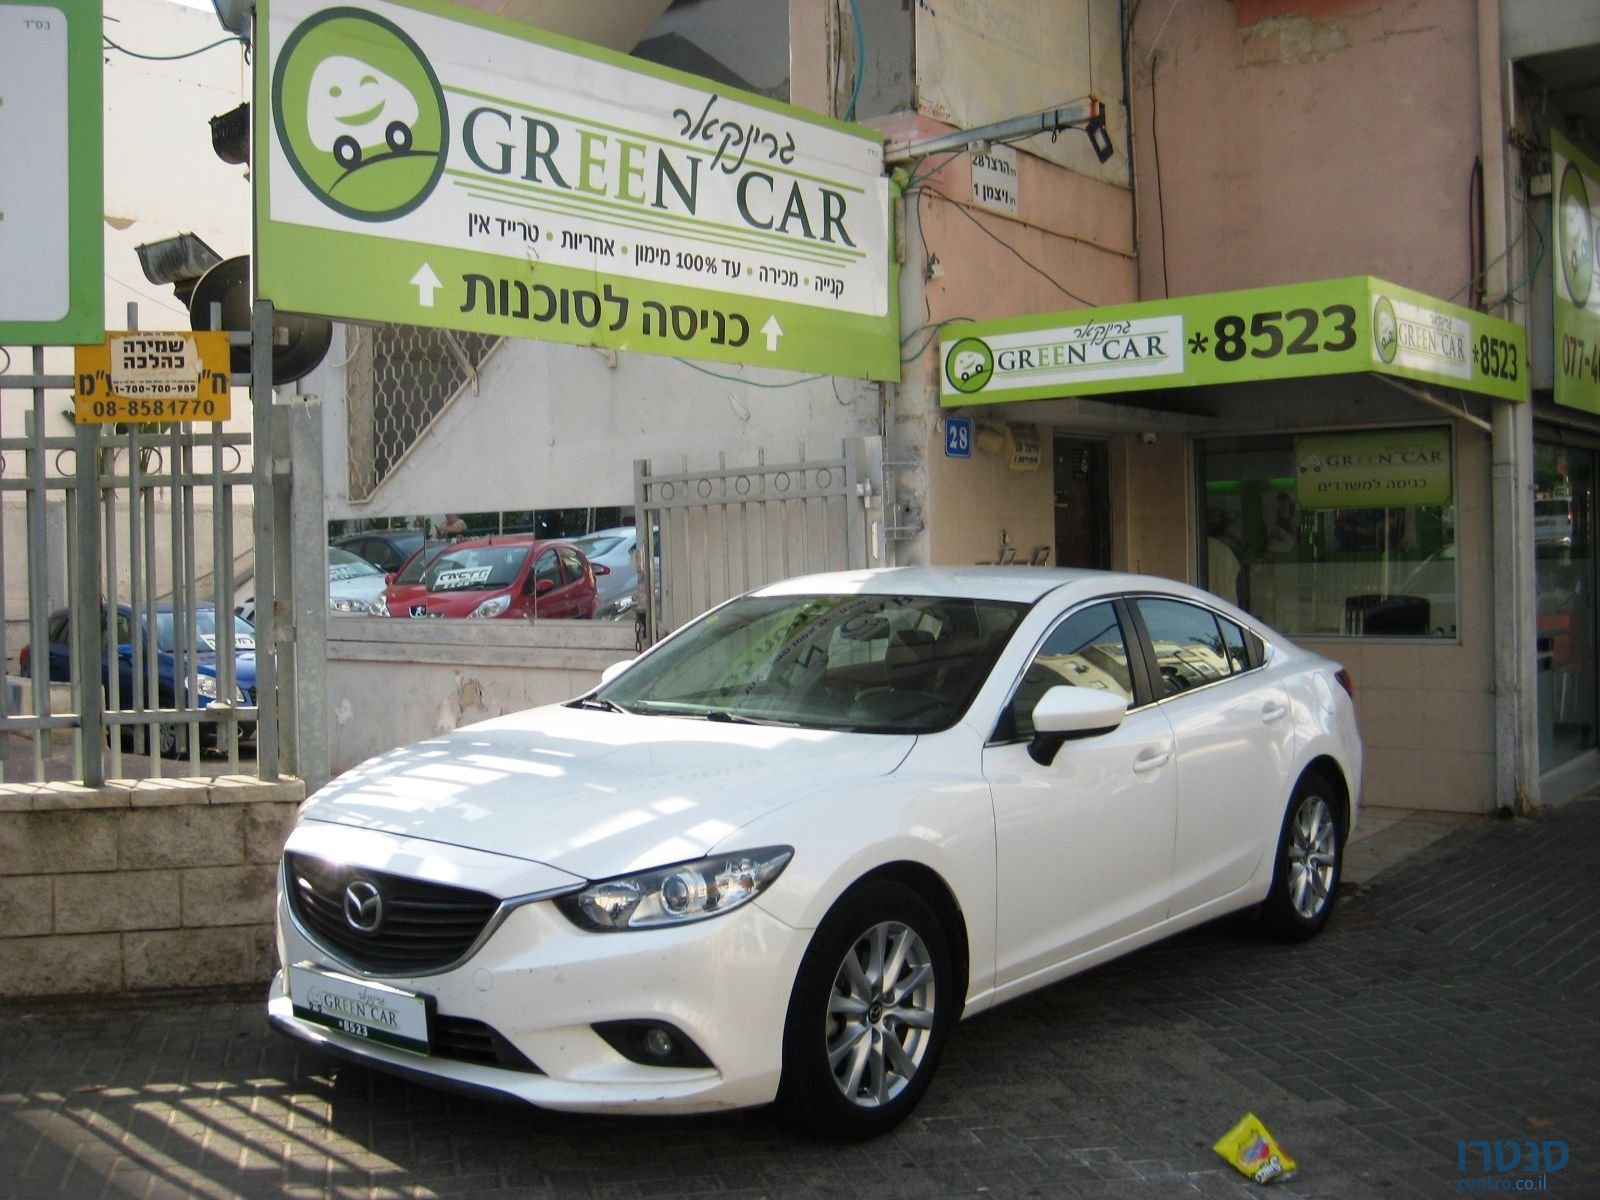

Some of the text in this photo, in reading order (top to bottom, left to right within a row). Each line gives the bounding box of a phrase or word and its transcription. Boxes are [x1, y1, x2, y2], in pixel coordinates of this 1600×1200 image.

[673, 94, 796, 175] גרינקאר
[462, 106, 857, 248] GREEN CAR
[973, 183, 979, 196] 1
[983, 184, 1008, 204] ויצמן
[468, 212, 845, 299] קנייה מכירה עד 100% מימון אחריות טרייד אין
[459, 273, 750, 348] כניסה לסוכנות
[1073, 318, 1132, 346] גרינקאר
[1399, 322, 1465, 360] GREEN CAR
[123, 340, 184, 353] שמירה
[998, 335, 1167, 371] GREEN CAR
[1562, 332, 1600, 386] 077-4
[123, 354, 185, 369] כהלכה
[93, 400, 215, 417] 08-8581770
[949, 425, 968, 450] 28
[1326, 451, 1442, 467] GREEN CAR
[1317, 478, 1427, 492] כניסה למשרדים
[324, 993, 398, 1028] GREEN CAR
